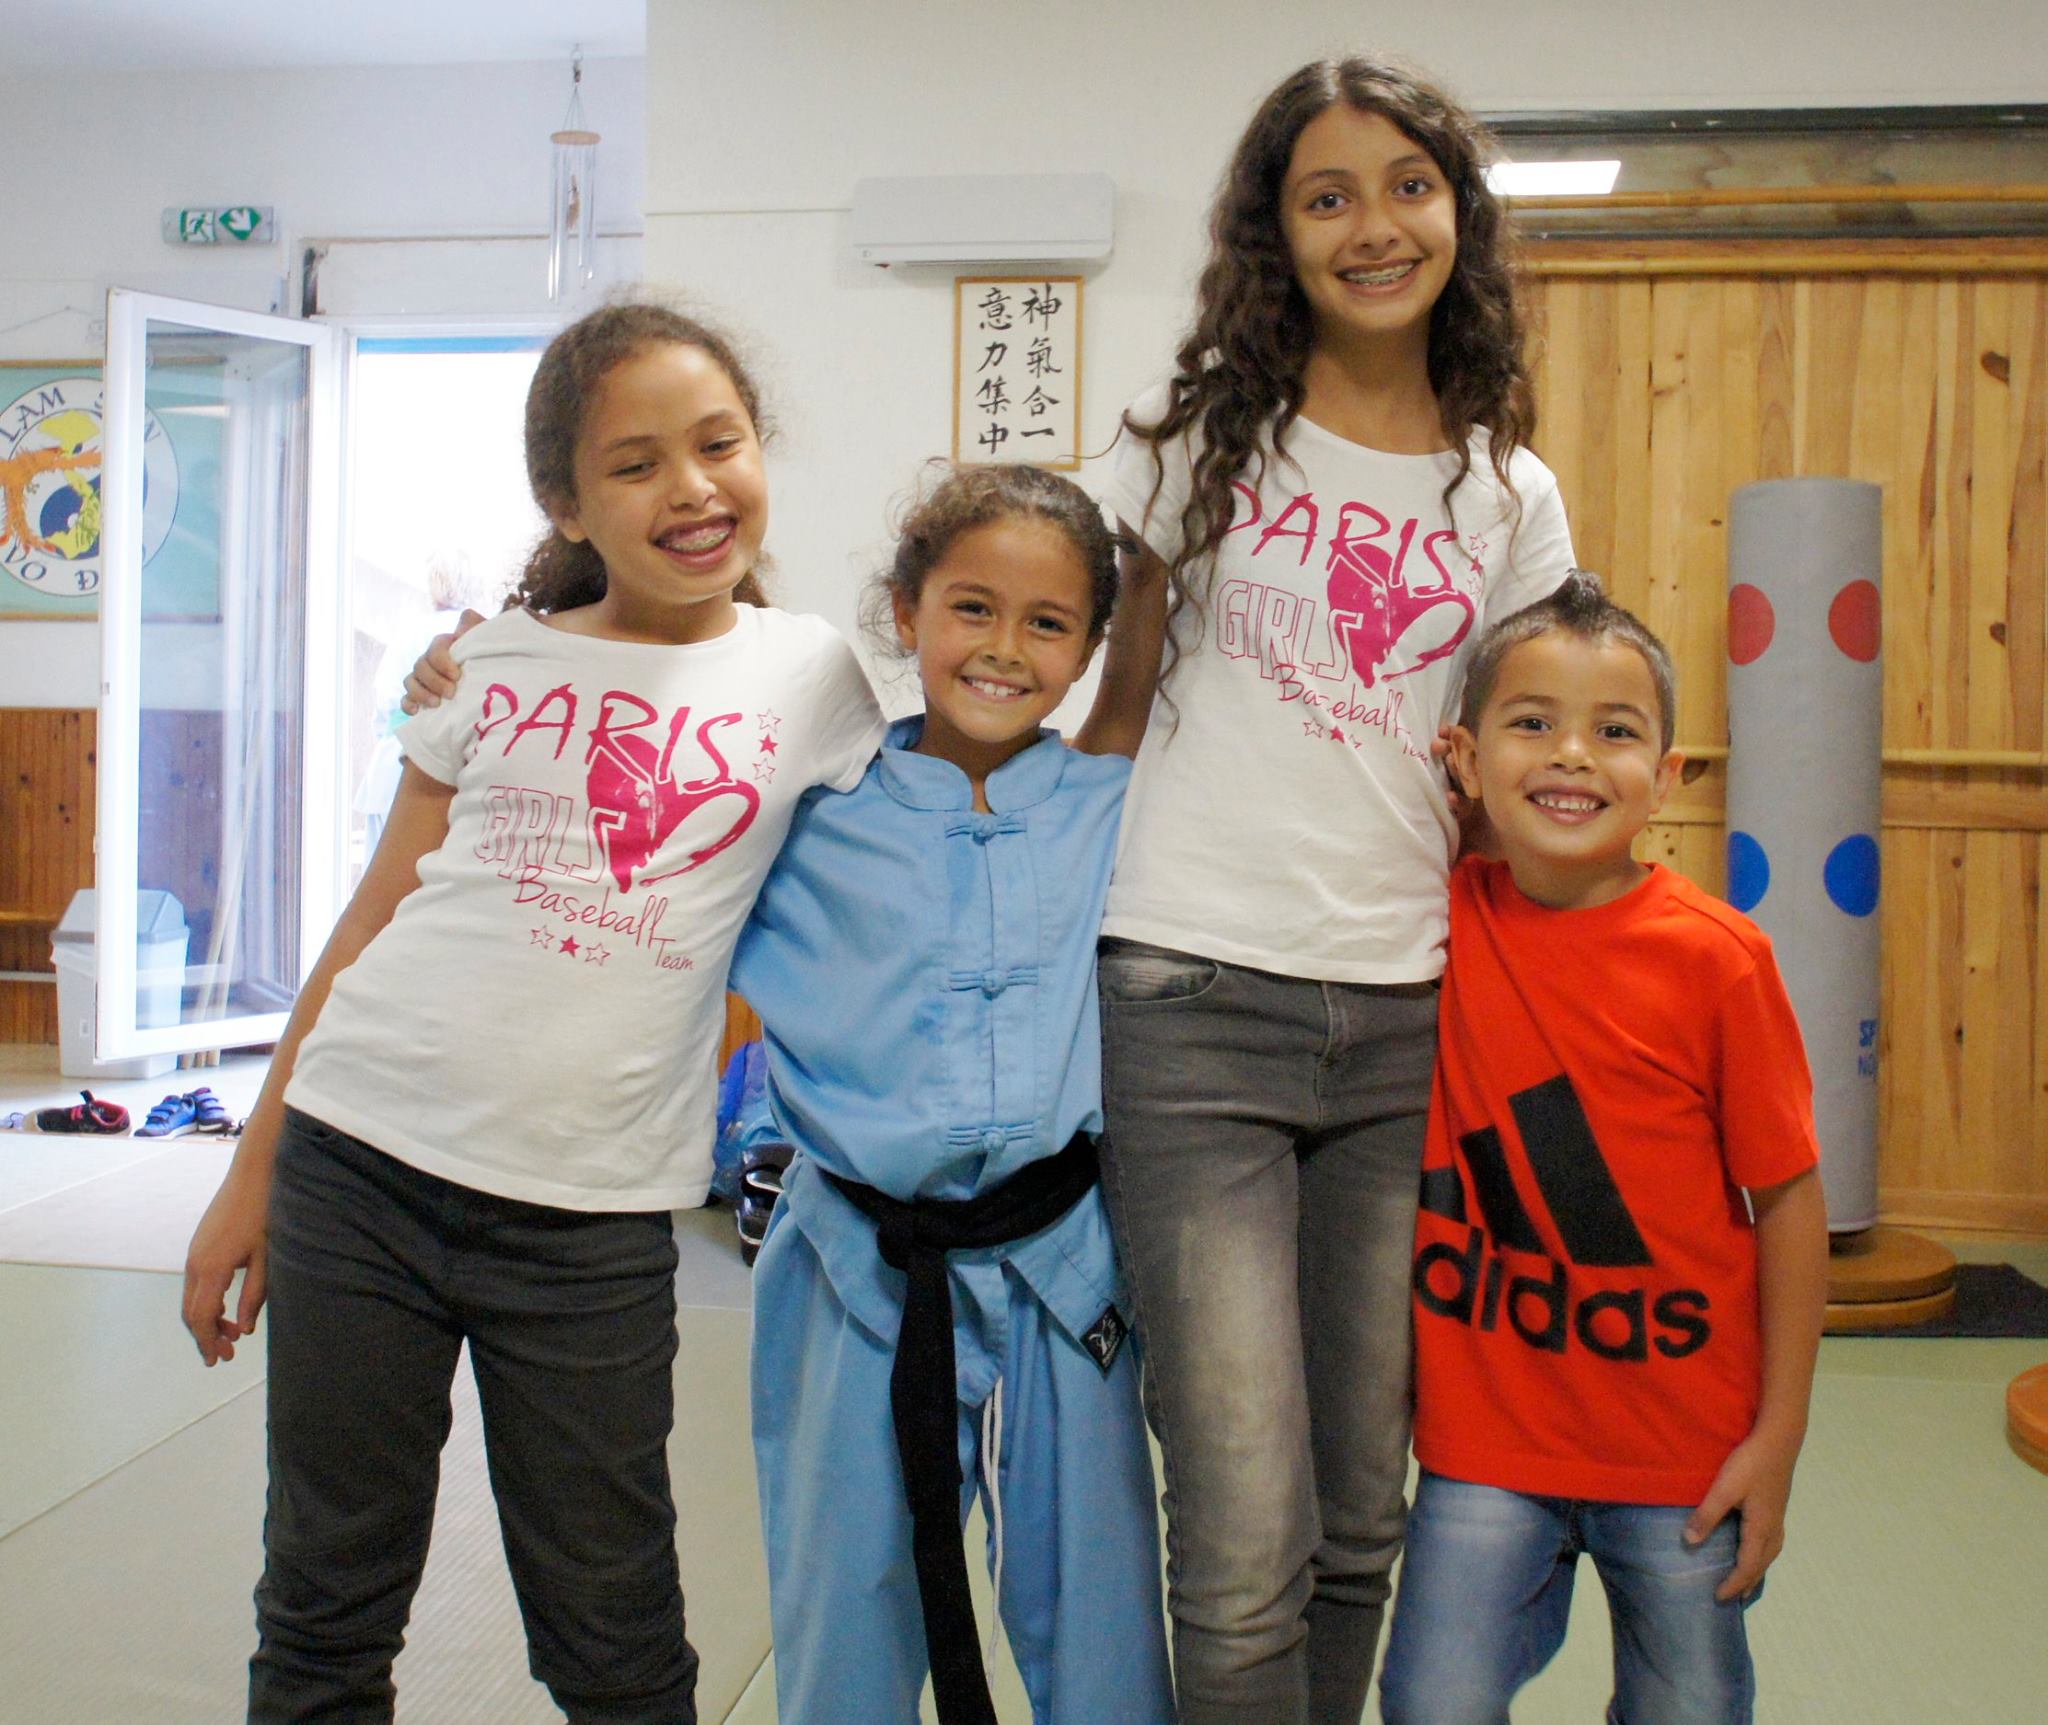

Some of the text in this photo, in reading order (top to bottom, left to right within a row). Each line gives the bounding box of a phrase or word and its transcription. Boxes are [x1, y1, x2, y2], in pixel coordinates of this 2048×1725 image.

[975, 287, 1013, 454] 意力集中
[1217, 579, 1363, 682] GIRLS
[474, 683, 743, 792] PARIS
[512, 866, 694, 971] Baseball Team
[1413, 1226, 1711, 1362] didas
